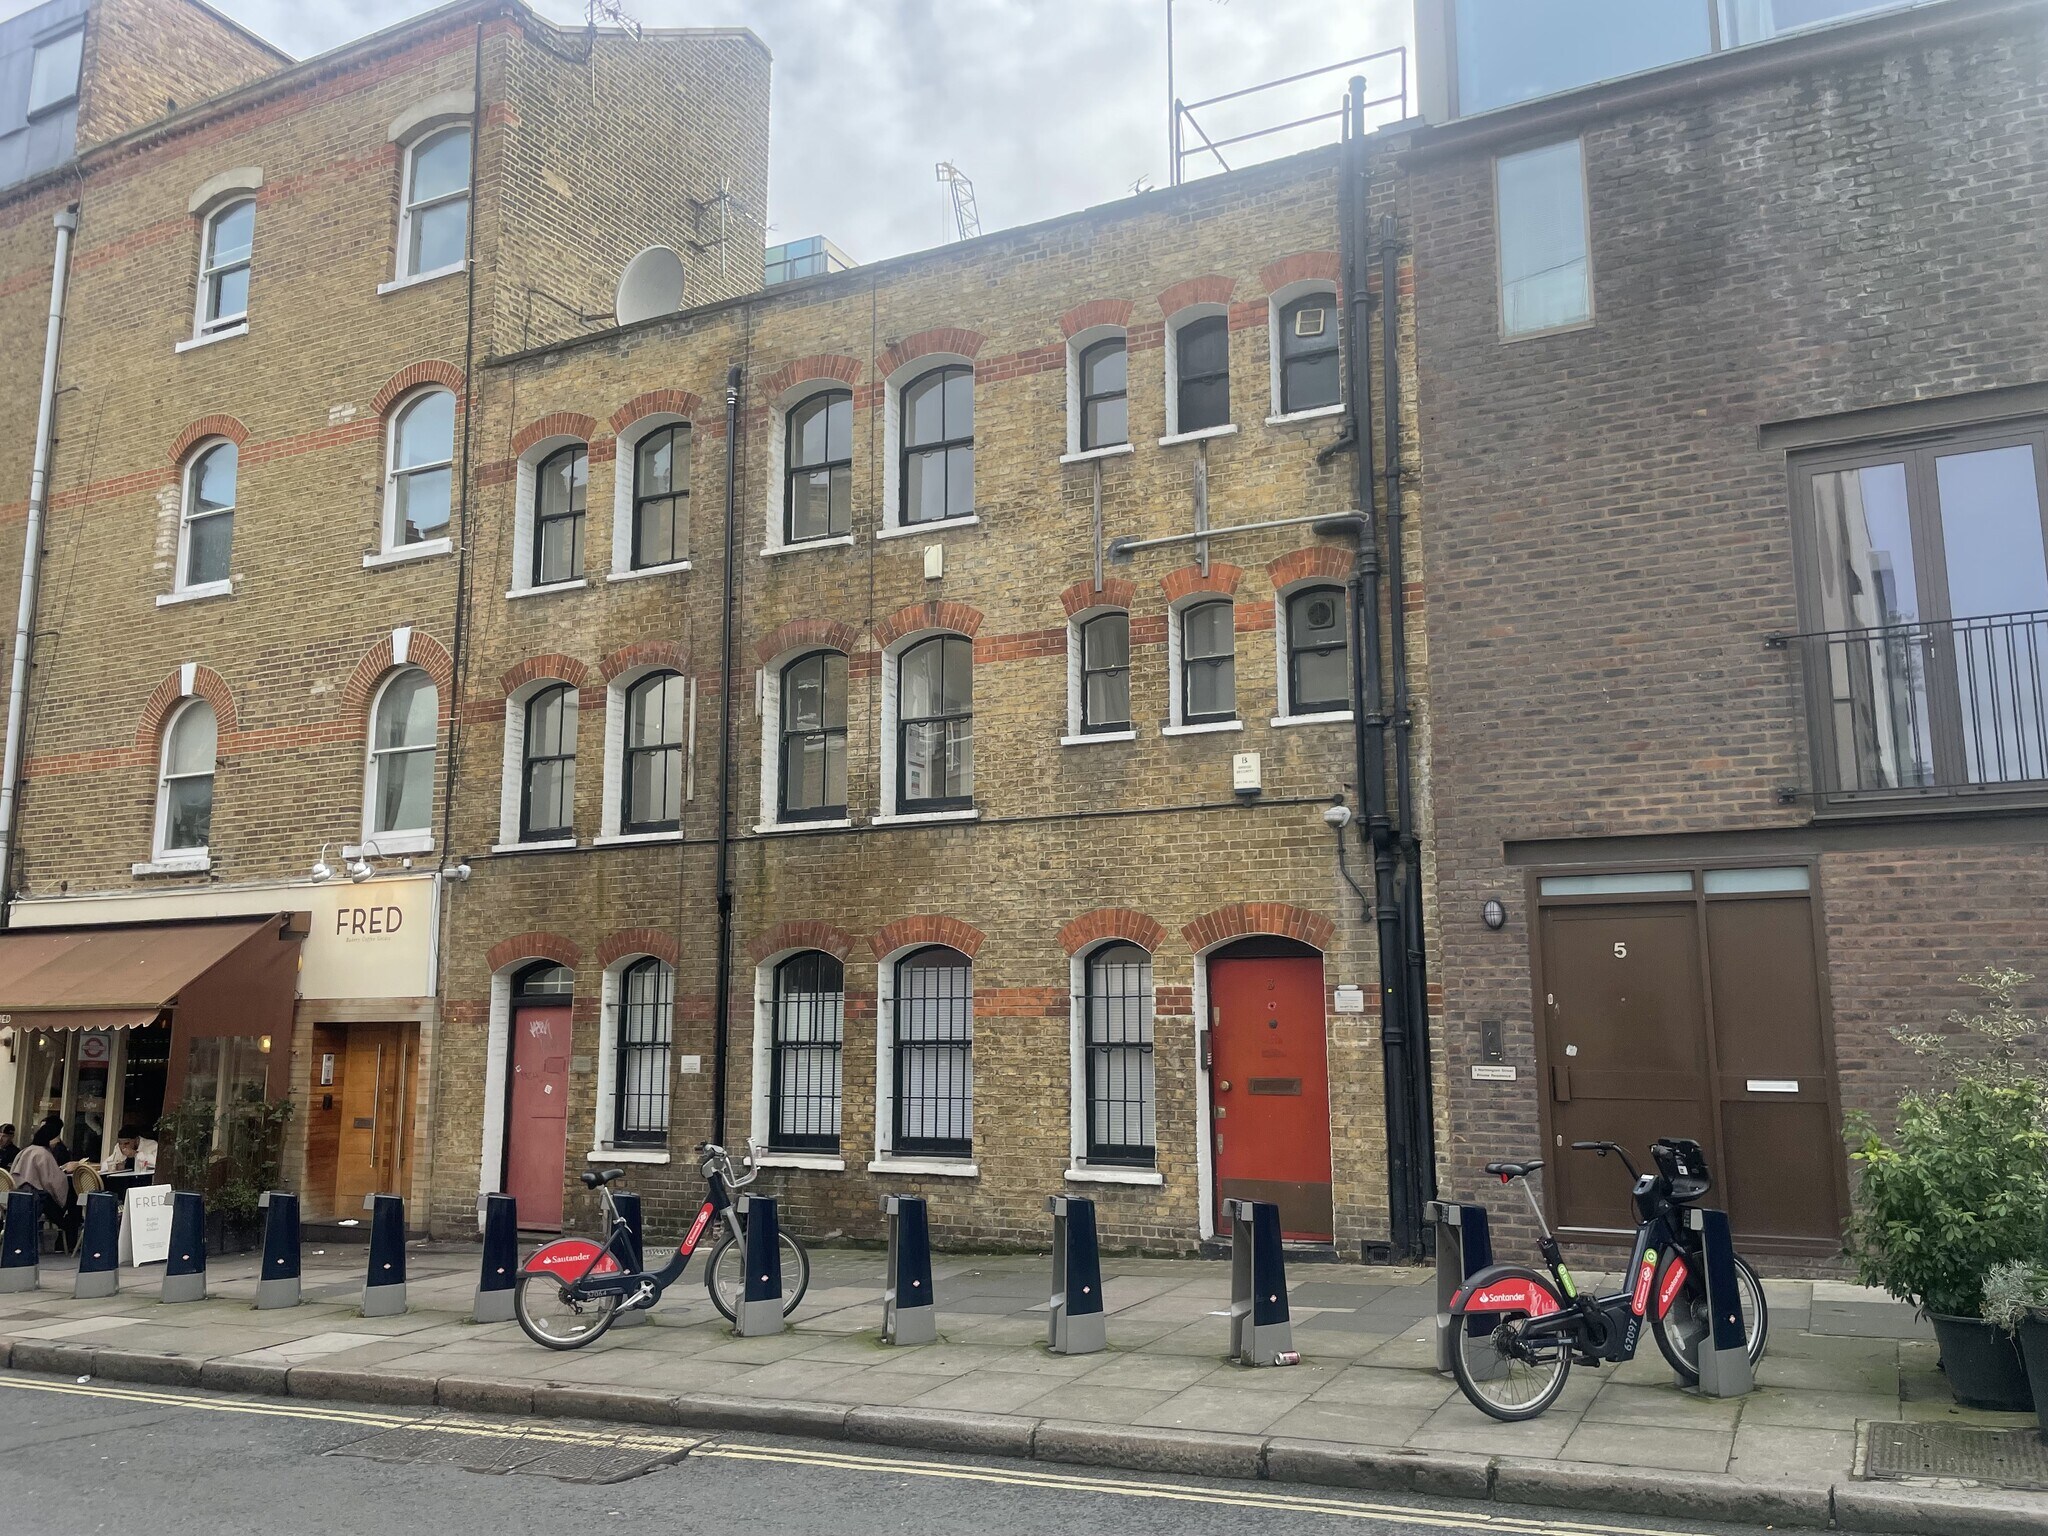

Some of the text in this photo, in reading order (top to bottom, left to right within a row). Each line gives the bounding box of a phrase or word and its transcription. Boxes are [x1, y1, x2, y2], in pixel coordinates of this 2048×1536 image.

[336, 906, 403, 936] FRED
[1614, 942, 1627, 959] 5
[551, 1252, 591, 1264] Santander
[1666, 1266, 1684, 1296] Santander
[1488, 1292, 1525, 1303] Santander
[1624, 1318, 1638, 1352] 62097
